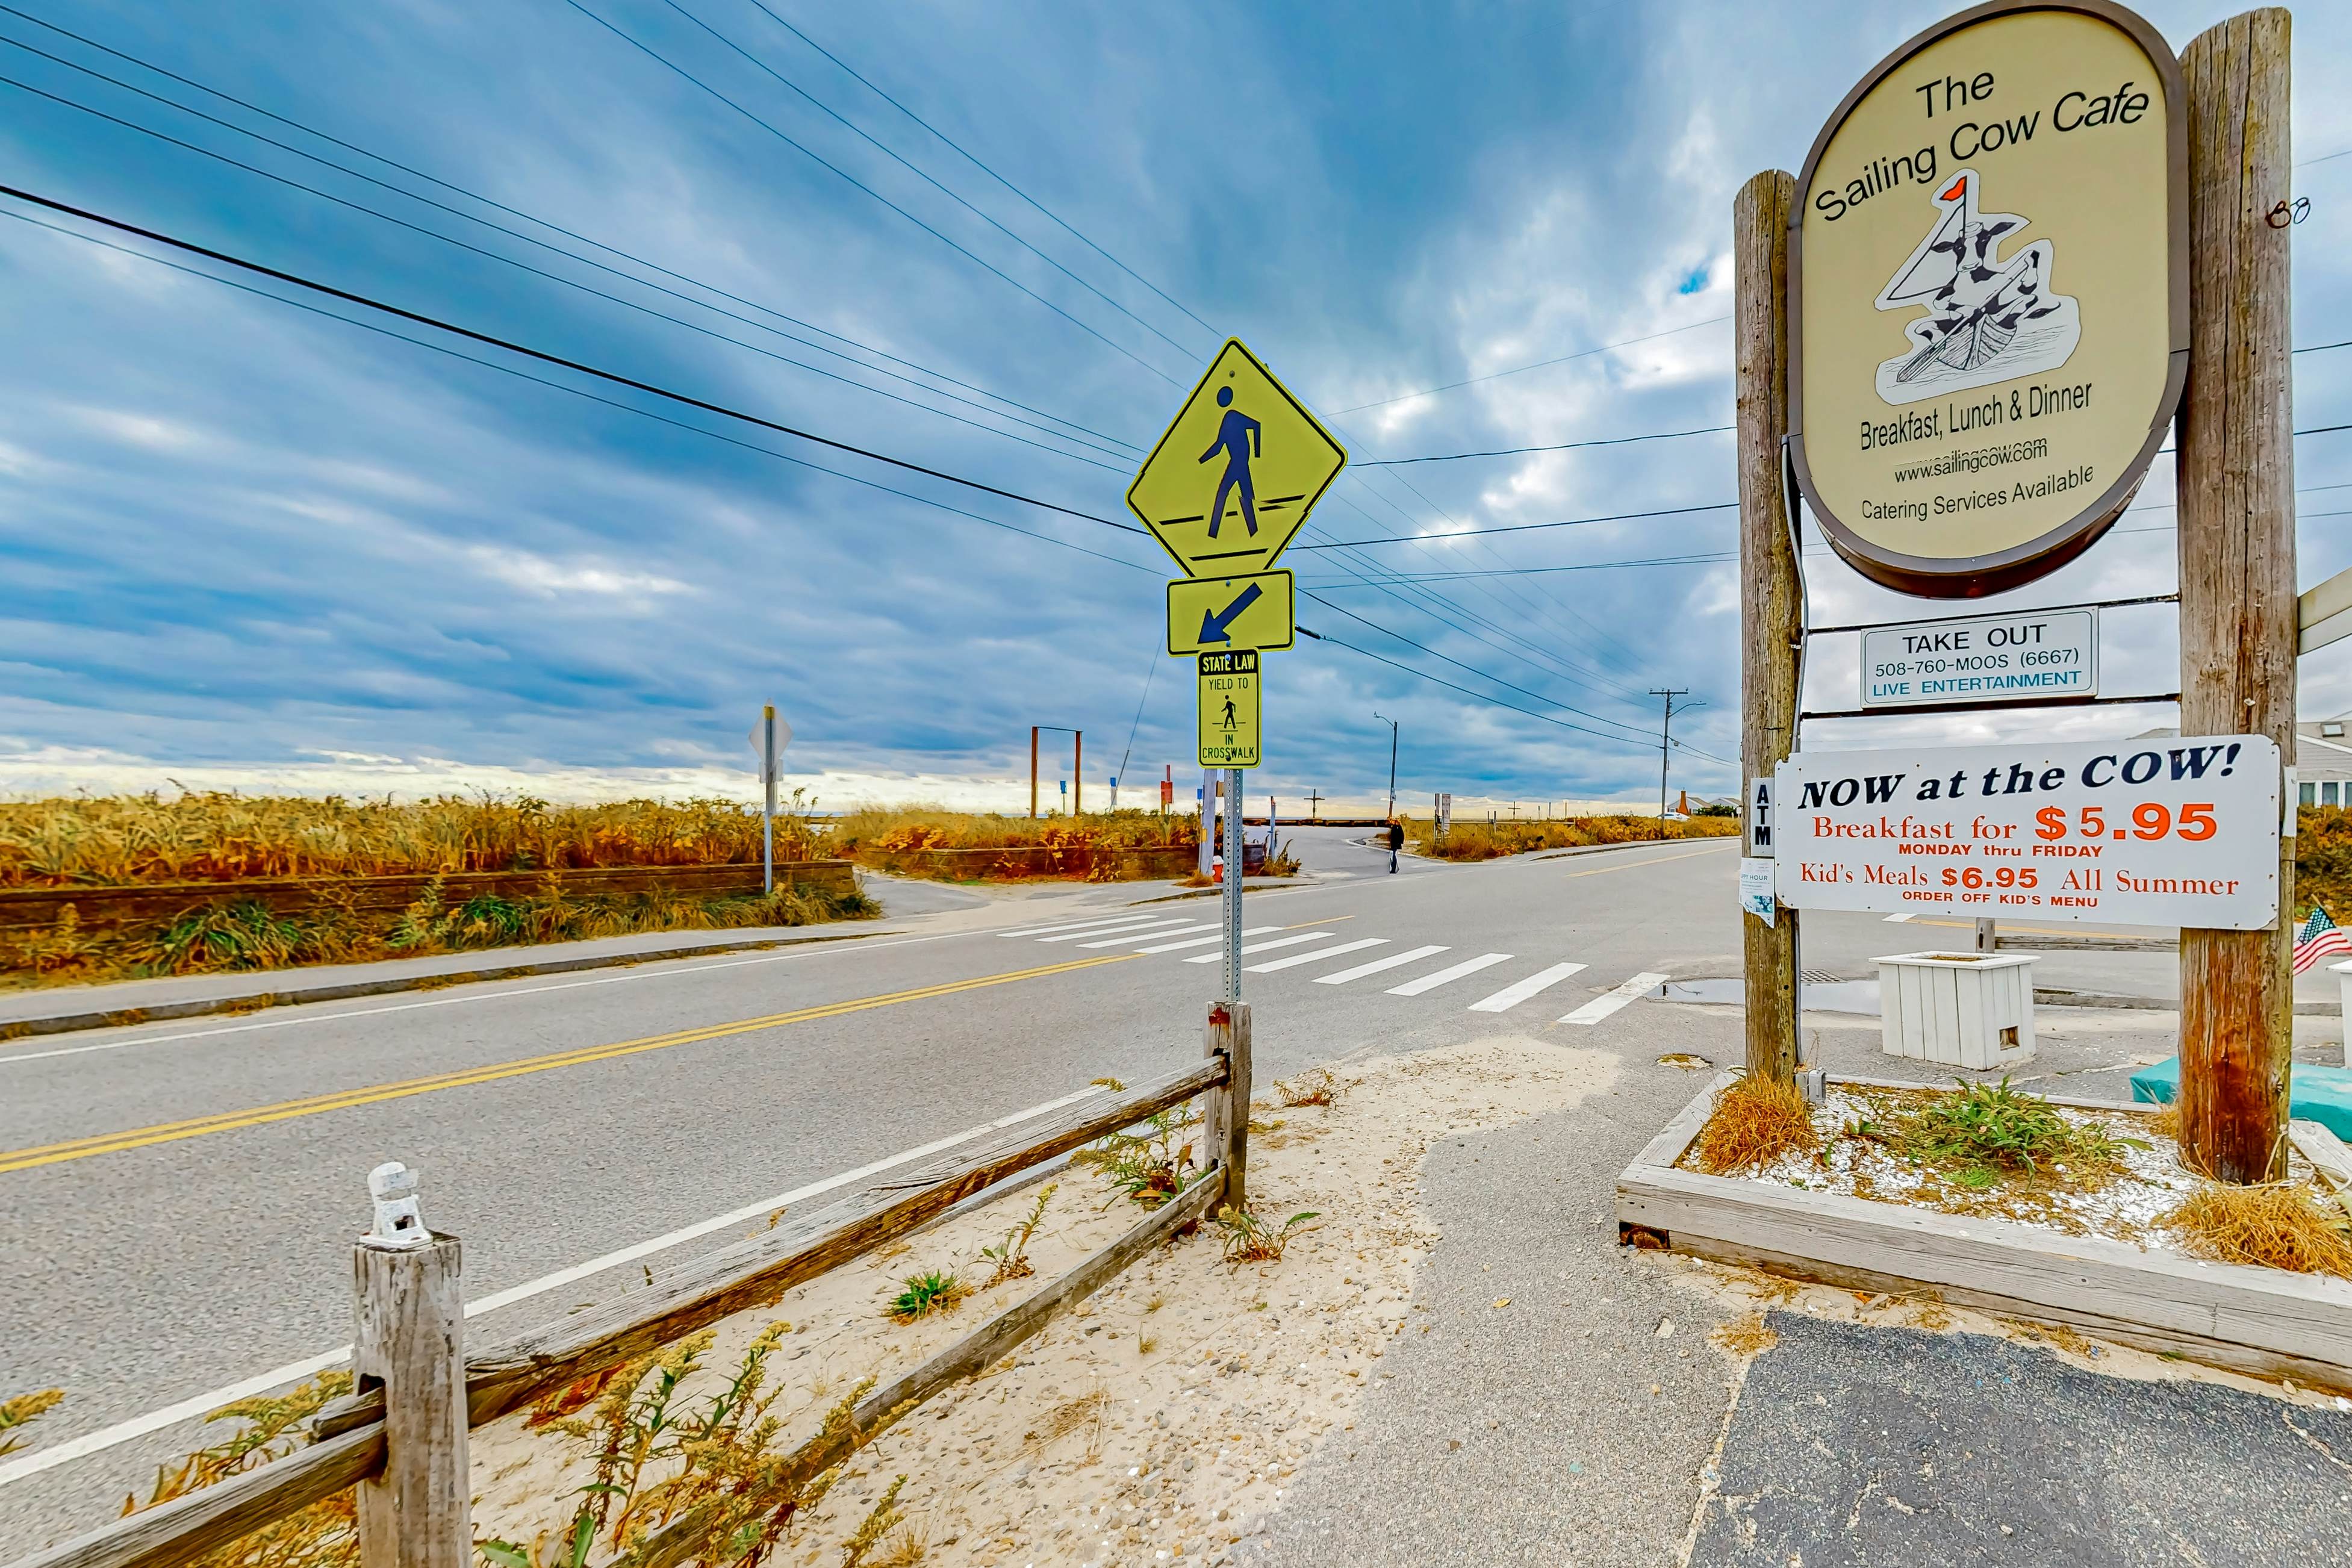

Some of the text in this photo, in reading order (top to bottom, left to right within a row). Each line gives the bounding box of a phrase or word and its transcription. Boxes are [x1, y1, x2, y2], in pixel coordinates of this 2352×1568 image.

[1916, 72, 1994, 119] The
[1815, 82, 2149, 221] Sailing Cow Cafe
[1861, 382, 2092, 450] Breakfast, Lunch & Dinner
[1895, 439, 2047, 483] www.sailingcow.com
[1862, 465, 2094, 521] Catering Services Available
[1903, 624, 2047, 654] TAKE OUT
[1202, 654, 1255, 672] STATE LAW
[1875, 647, 2079, 677] 508-760-MOOS (6667)
[1209, 677, 1248, 690] YIELD TO
[1873, 670, 2082, 697] LIVE ENTERTAINMENT
[1202, 747, 1254, 759] CROSSWALK
[1225, 734, 1233, 745] IN
[1797, 743, 2242, 810] NOW at the COW!
[1755, 783, 1771, 846] ATM
[1812, 802, 2217, 842] Breakfast for $5.95
[1899, 844, 2103, 857] MONDAY thru FRIDAY
[1800, 862, 2240, 895] Kid's Meals $6.95 All Summer
[1902, 891, 2098, 907] ORDER OFF KID'S MENU
